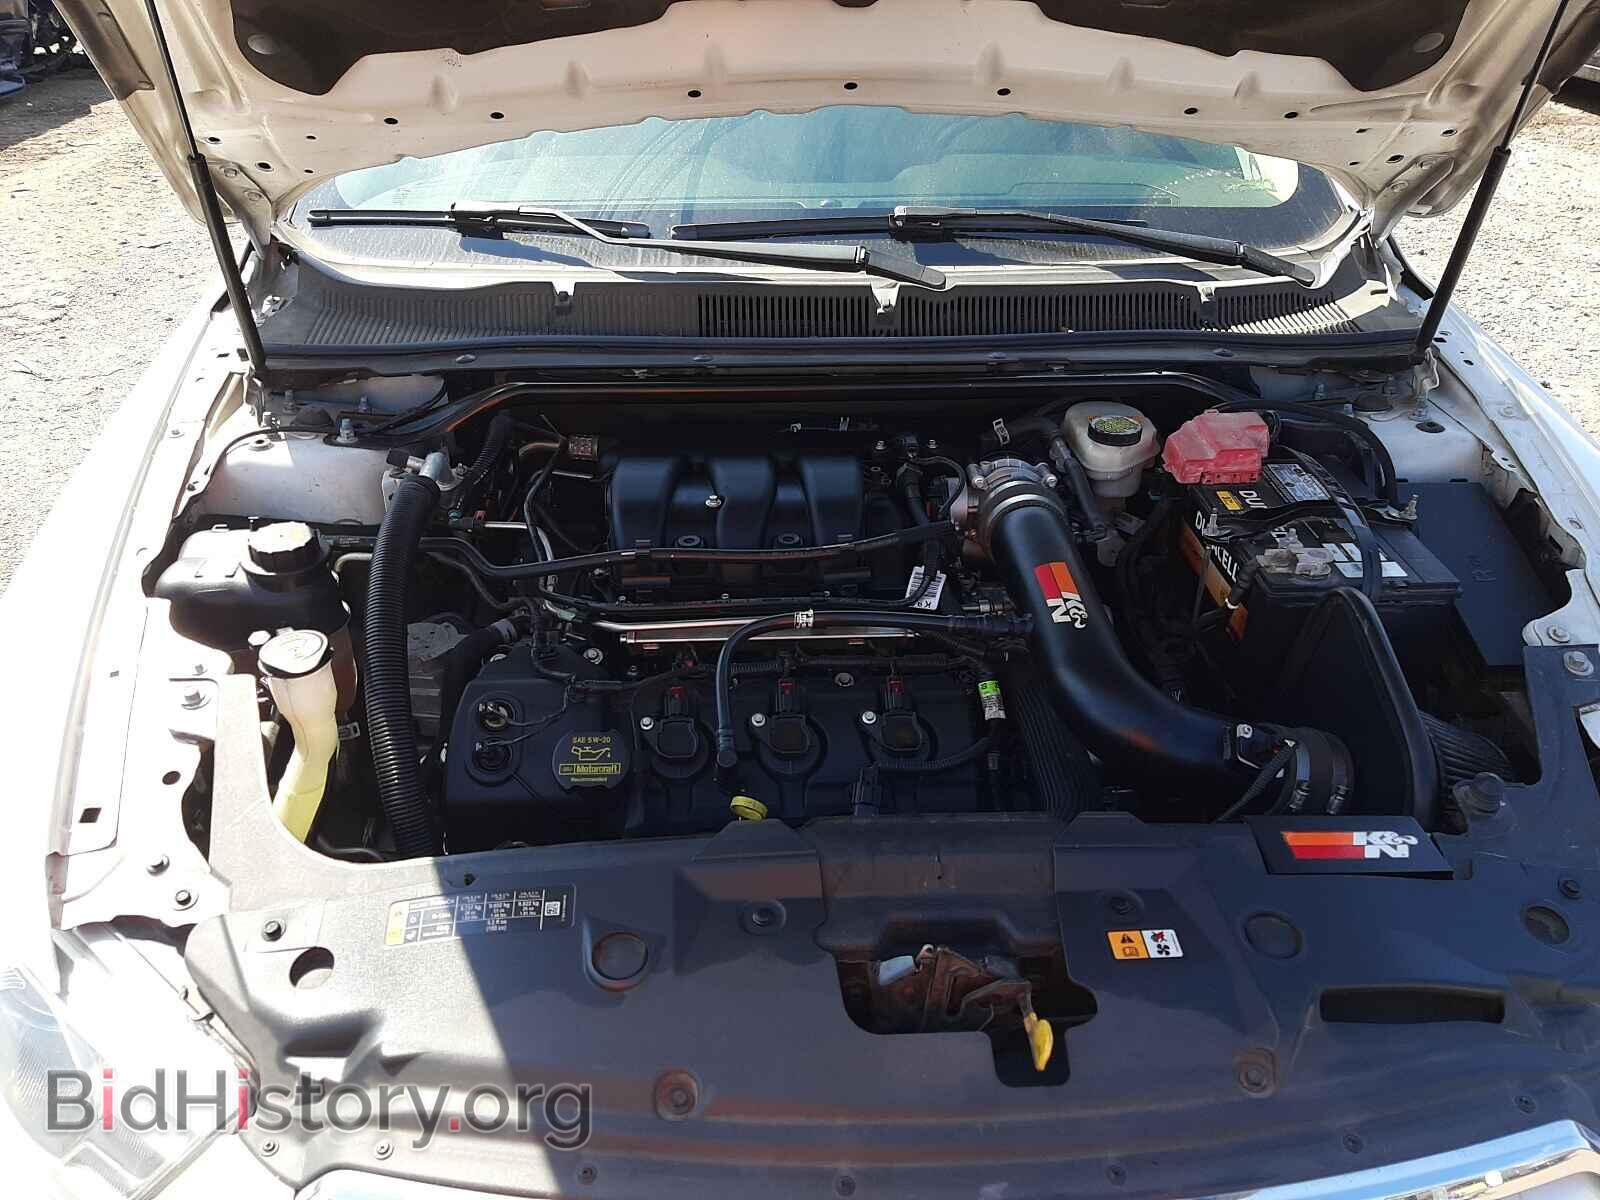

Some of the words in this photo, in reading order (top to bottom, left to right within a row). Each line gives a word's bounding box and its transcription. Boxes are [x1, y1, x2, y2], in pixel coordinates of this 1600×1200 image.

[573, 736, 586, 744] SAE
[588, 736, 611, 744] 5W-20
[576, 764, 618, 774] Motorcraft
